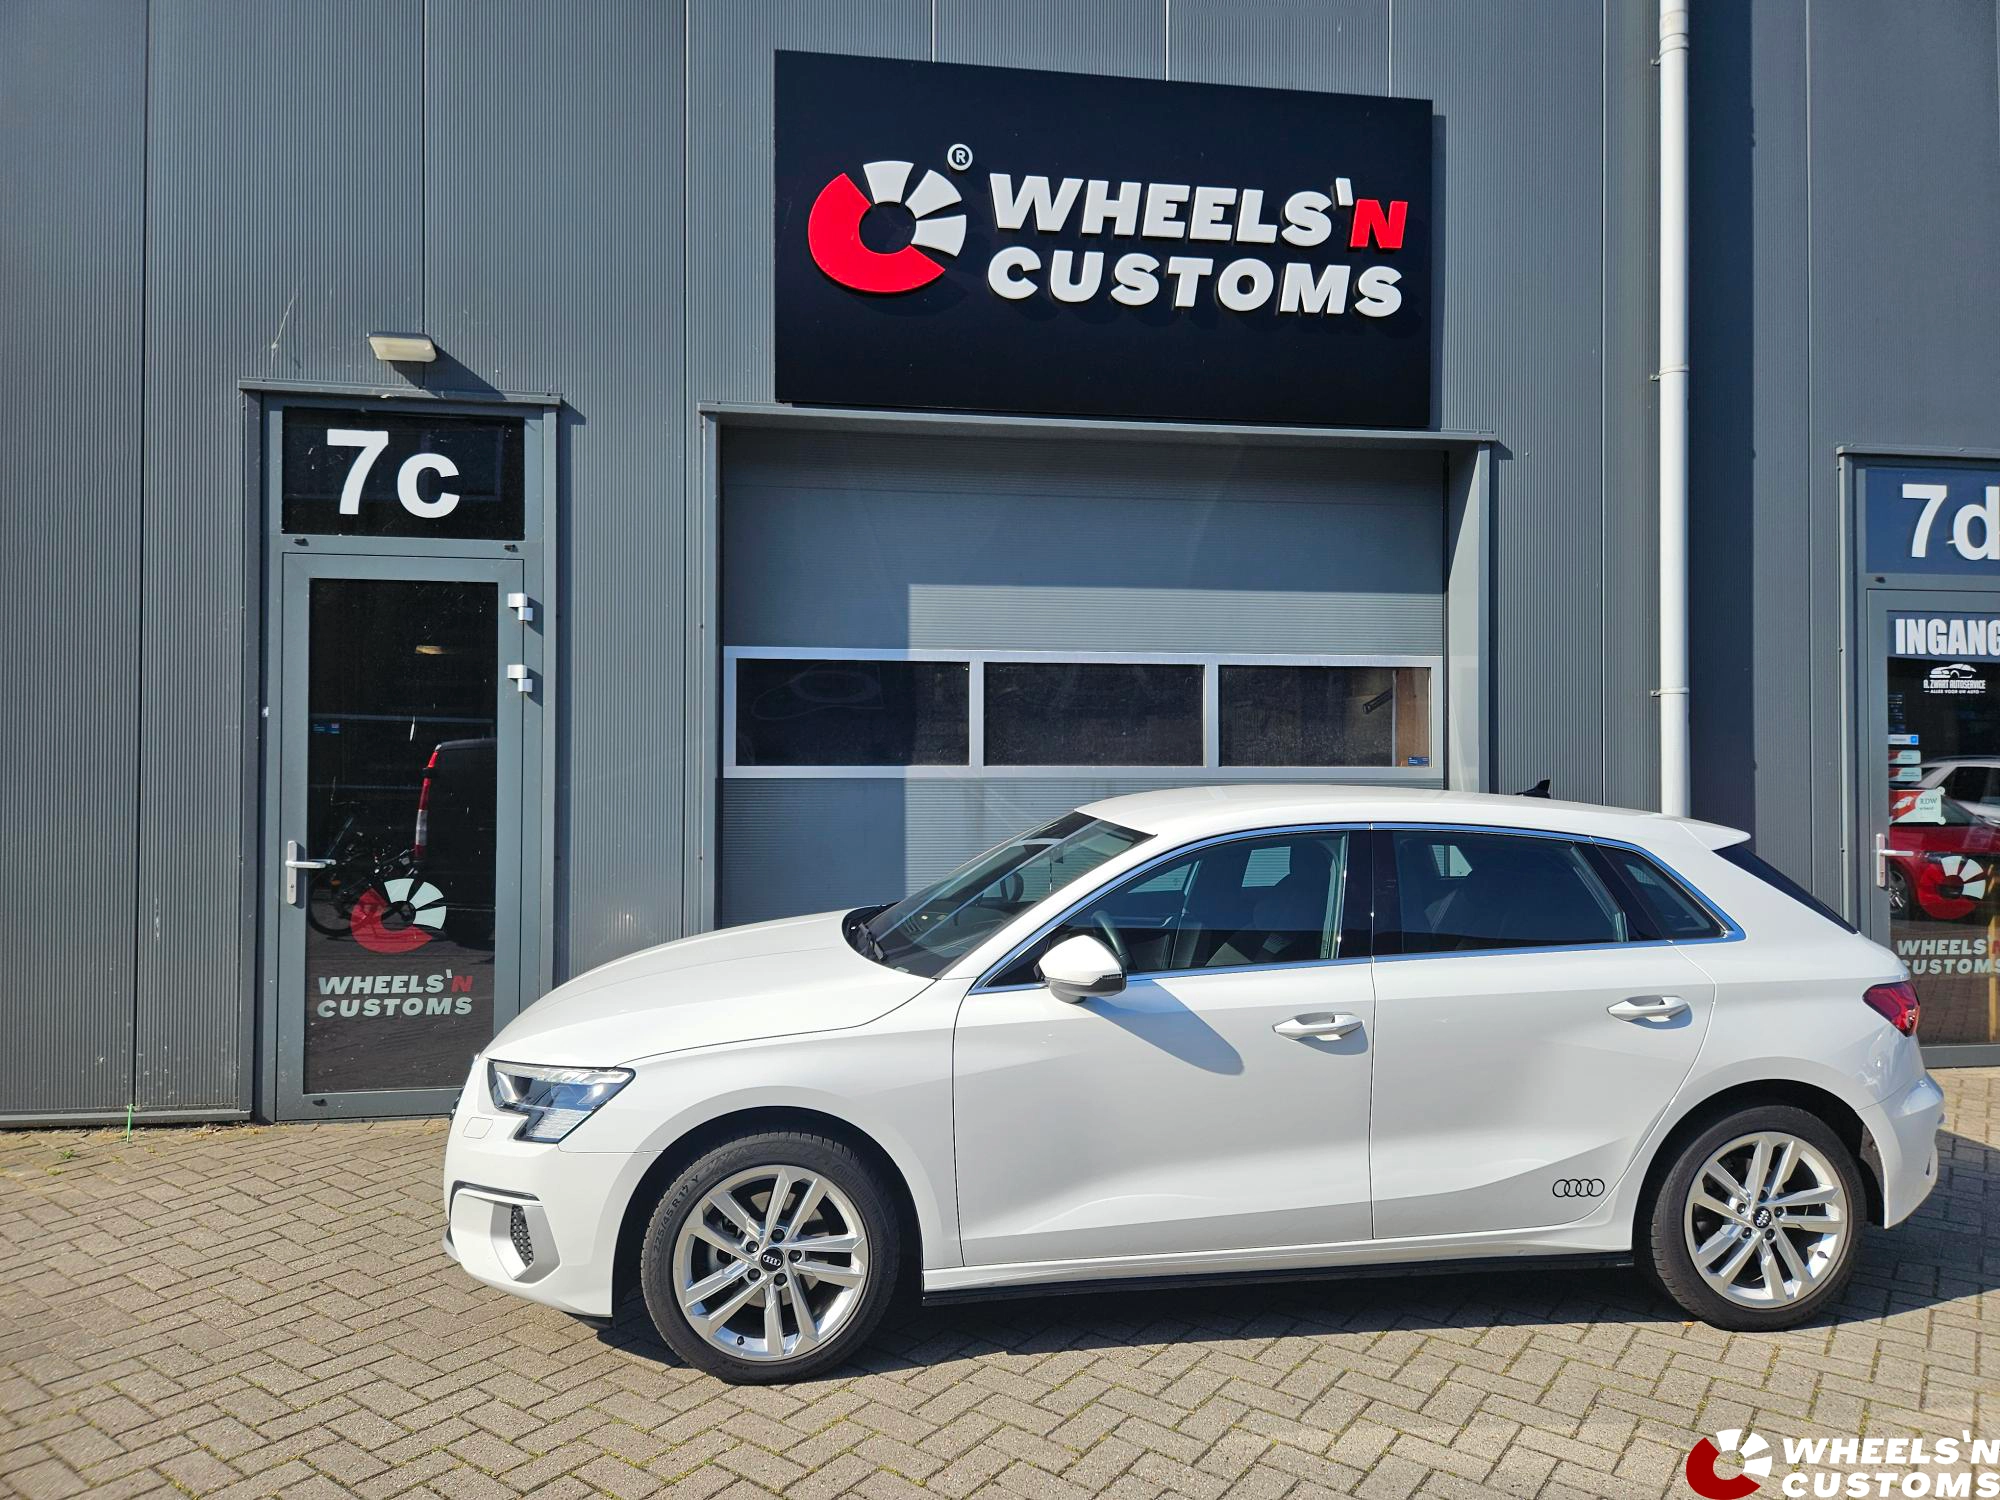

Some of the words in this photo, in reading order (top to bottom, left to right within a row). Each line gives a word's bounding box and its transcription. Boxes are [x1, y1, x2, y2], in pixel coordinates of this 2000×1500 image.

[989, 172, 1409, 249] WHEELS'N
[987, 245, 1402, 318] CUSTOMS
[326, 428, 461, 519] 7c
[1902, 483, 2000, 560] 7d
[1895, 617, 2000, 656] INGANG
[1949, 679, 1987, 690] AUTOSERVICE
[317, 996, 473, 1018] CUSTOMS
[318, 968, 473, 995] WHEELS'N
